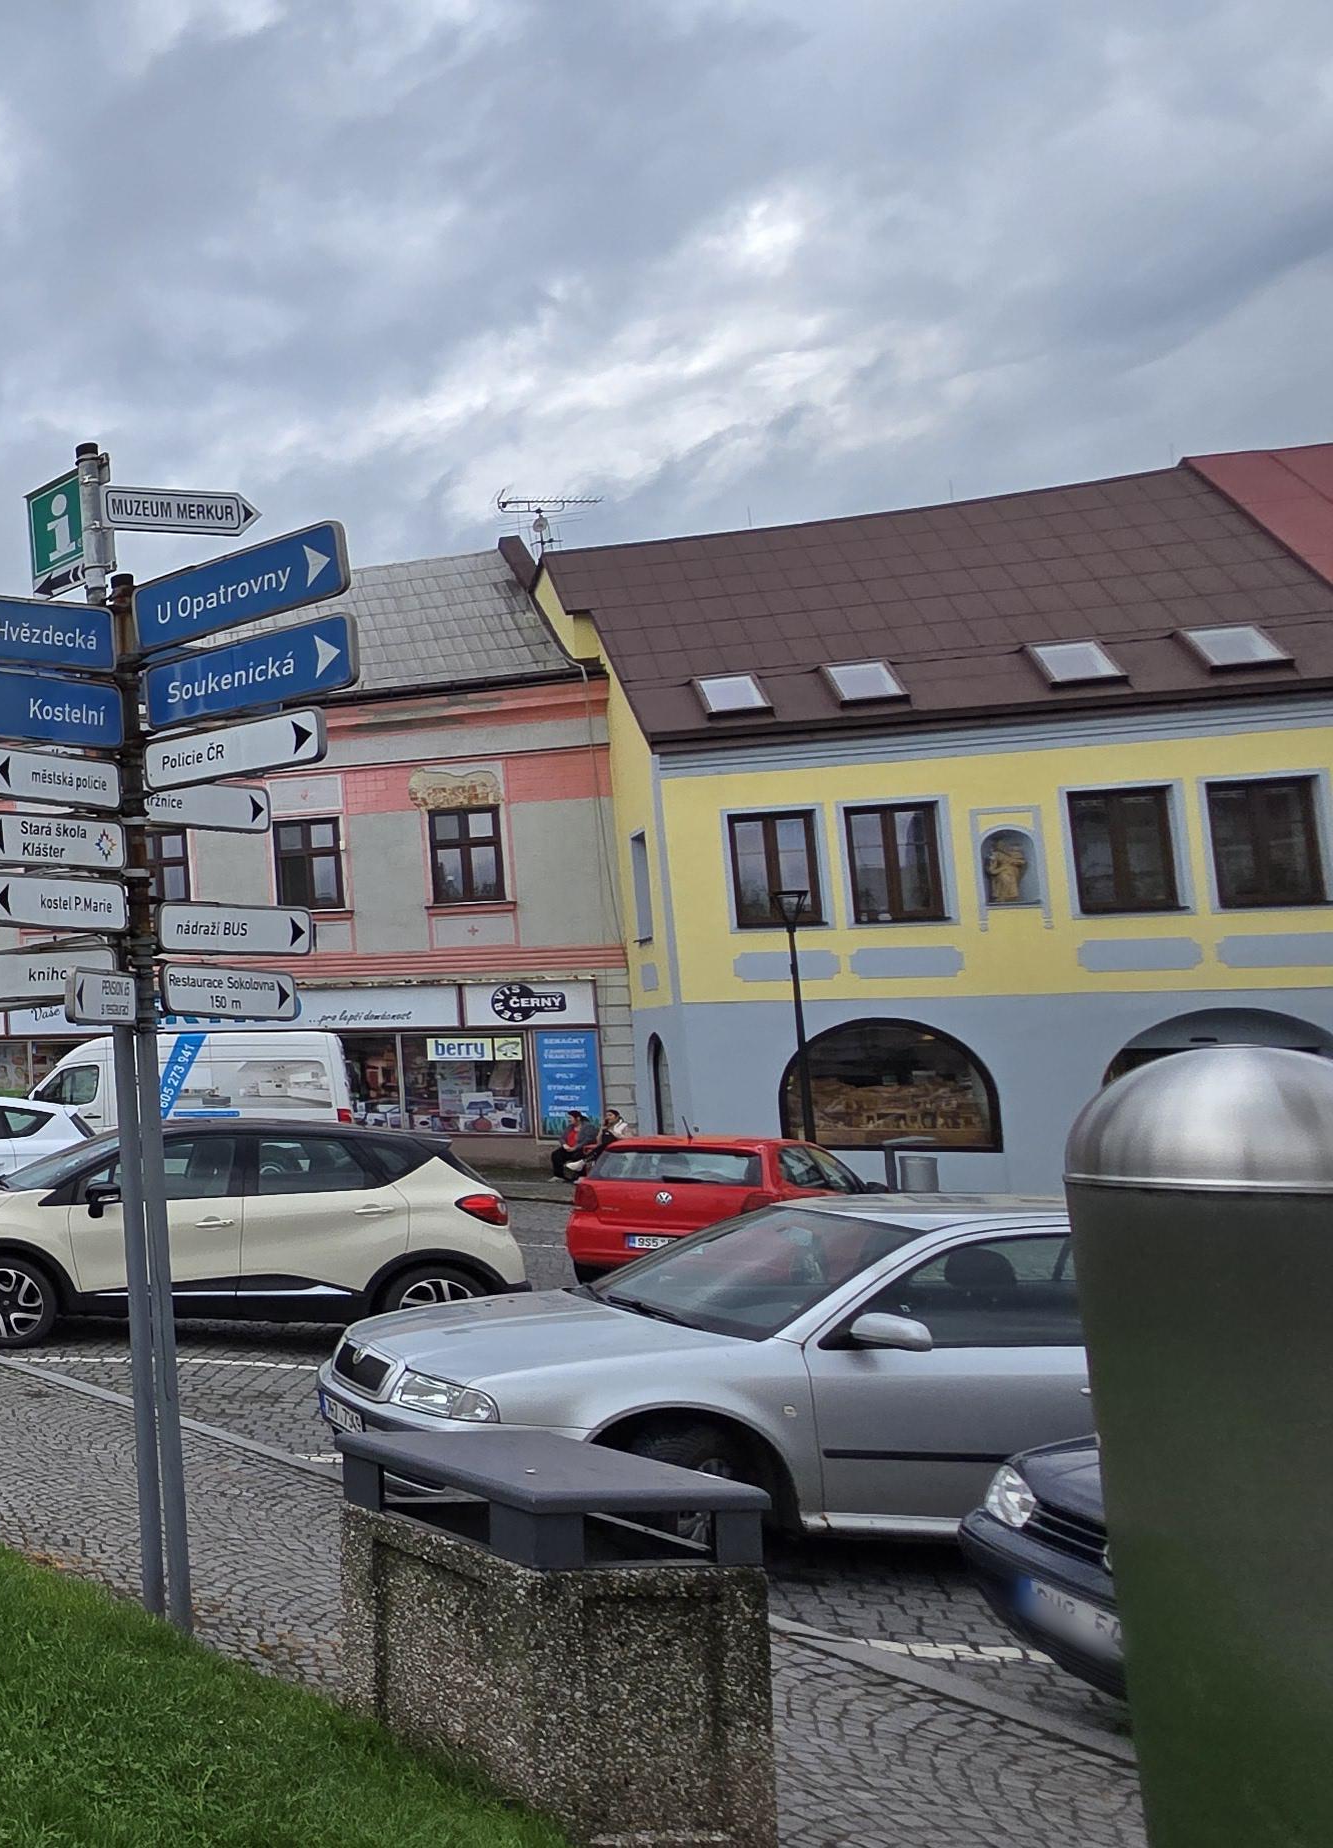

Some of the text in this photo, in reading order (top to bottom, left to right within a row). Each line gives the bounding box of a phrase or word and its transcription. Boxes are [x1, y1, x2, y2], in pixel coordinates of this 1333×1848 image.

[111, 498, 234, 521] MUZEUM MERKUR
[157, 566, 291, 624] U Opatrovny
[167, 651, 295, 703] Soukenická
[29, 698, 106, 726] Kostelní
[162, 743, 225, 771] Policie ČR
[31, 769, 108, 791] městská policie
[20, 820, 87, 839] Stará škola
[21, 841, 66, 859] Klášter
[40, 893, 113, 914] kostel P.Marie
[175, 920, 248, 937] nádraží BUS
[168, 973, 276, 991] Restaurace Sokolovna
[209, 995, 242, 1010] 150 m
[509, 993, 562, 1008] ČERNÝ
[30, 1005, 61, 1021] Vaše
[434, 1039, 485, 1059] berry
[167, 1065, 185, 1087] 273
[177, 1043, 195, 1063] 941
[637, 1237, 659, 1247] 9S5
